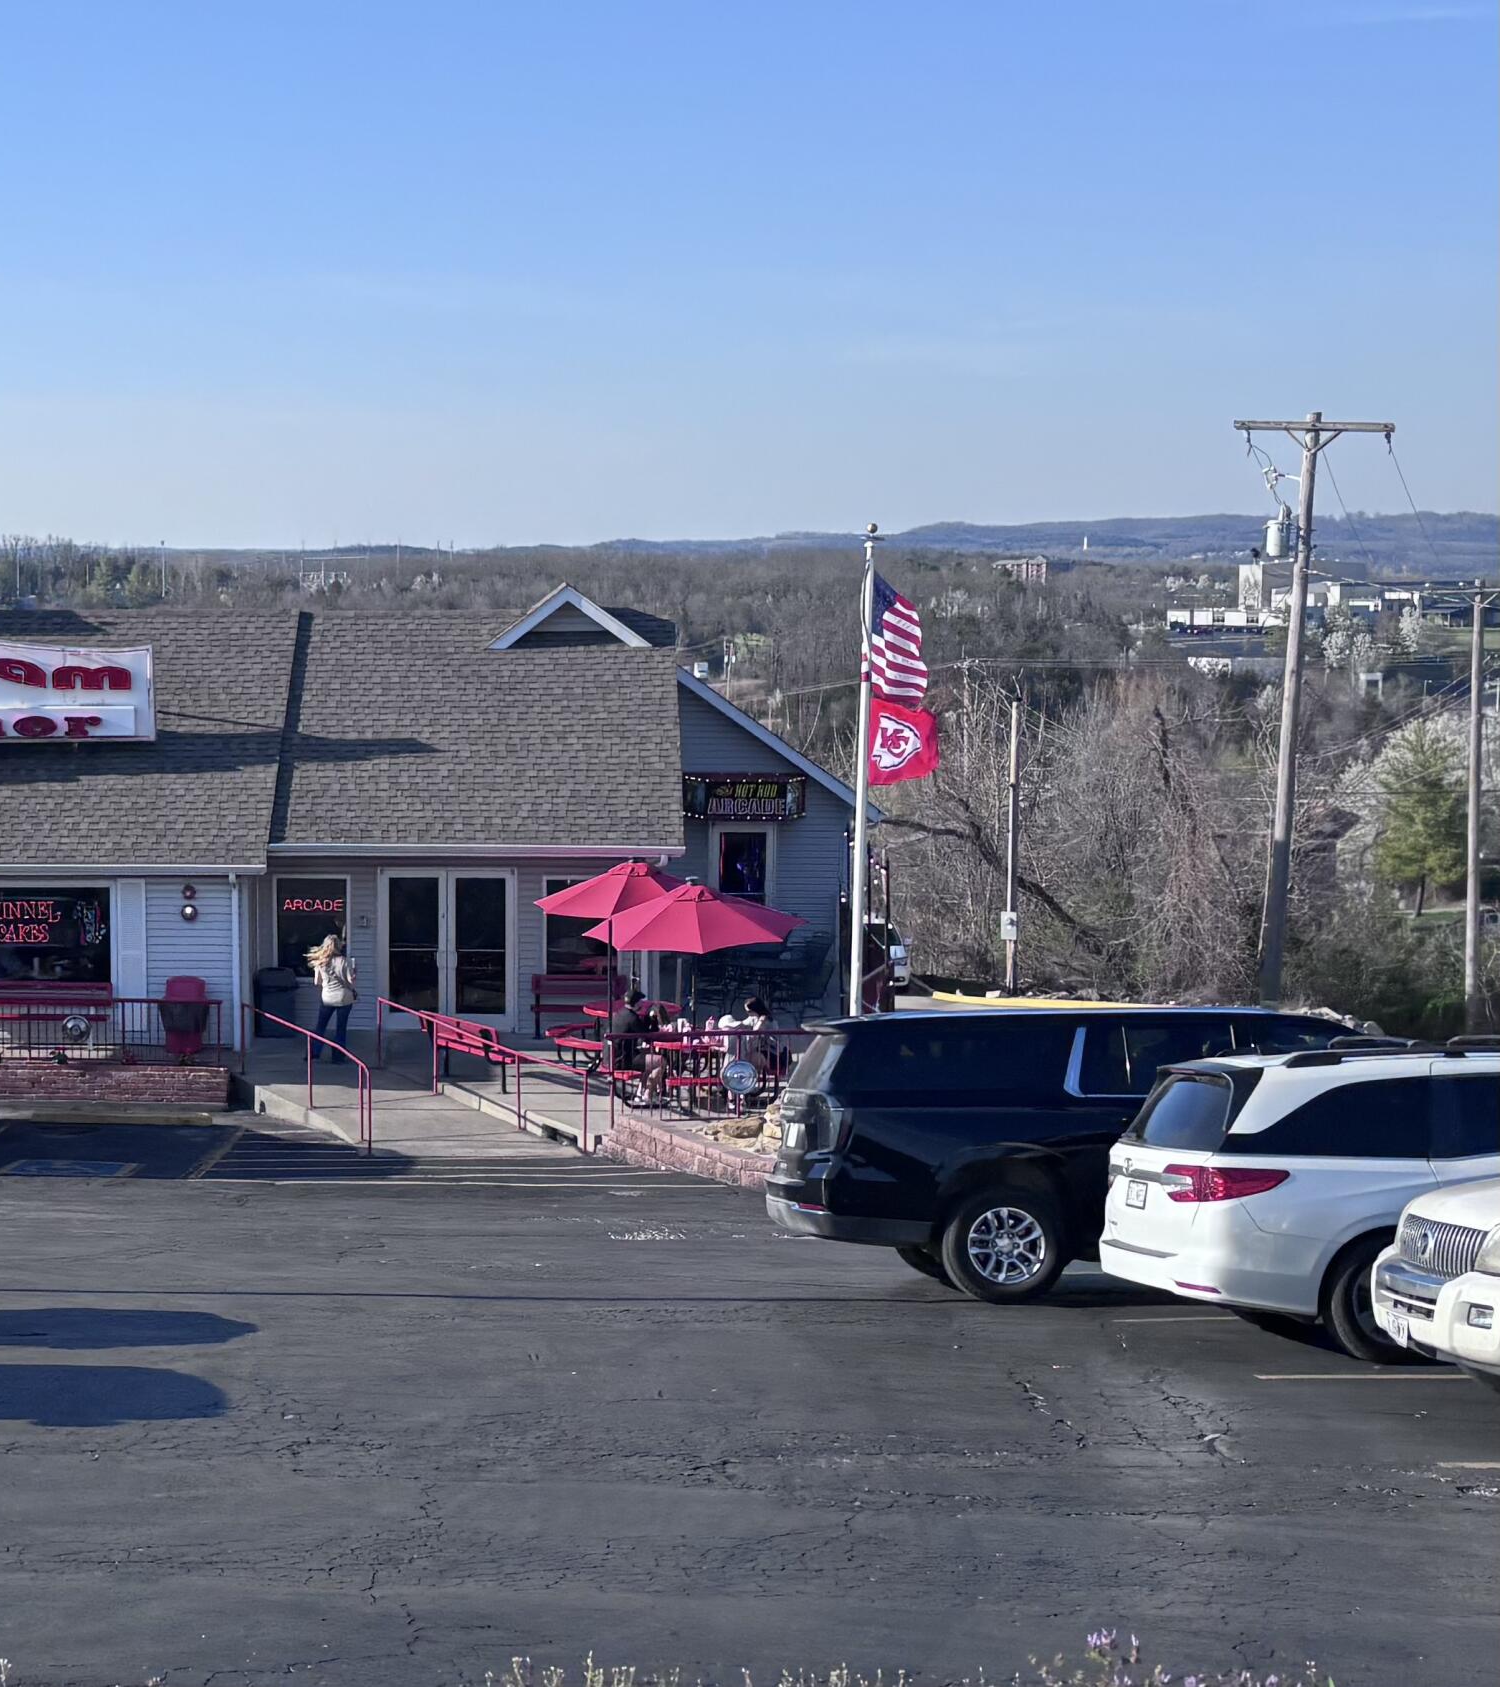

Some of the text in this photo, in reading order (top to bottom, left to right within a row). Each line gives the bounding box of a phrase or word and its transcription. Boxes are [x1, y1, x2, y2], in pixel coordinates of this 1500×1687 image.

[735, 784, 778, 797] HOT ROD
[708, 799, 785, 814] ARCADE
[283, 899, 344, 911] ARCADE
